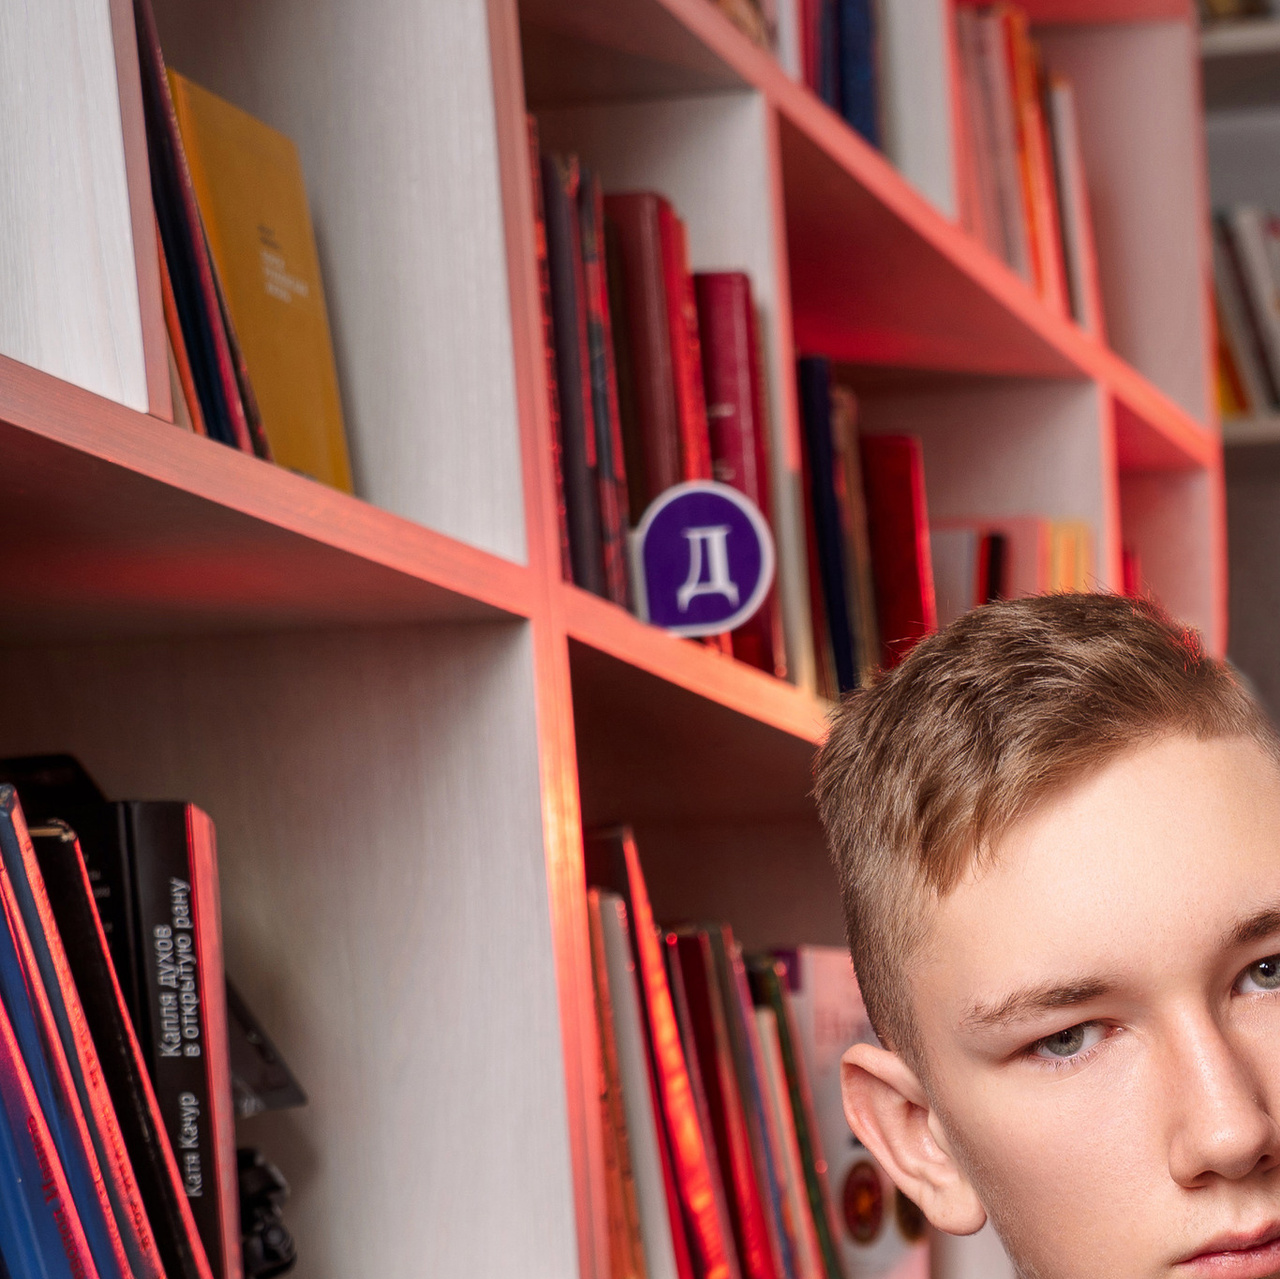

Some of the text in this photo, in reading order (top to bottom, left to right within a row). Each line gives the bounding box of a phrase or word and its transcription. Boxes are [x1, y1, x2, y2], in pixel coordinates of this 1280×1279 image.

[676, 526, 740, 614] Д
[153, 925, 183, 1057] Капля духов
[169, 877, 201, 1057] в открытую рану
[178, 1092, 203, 1197] Катя Качур
